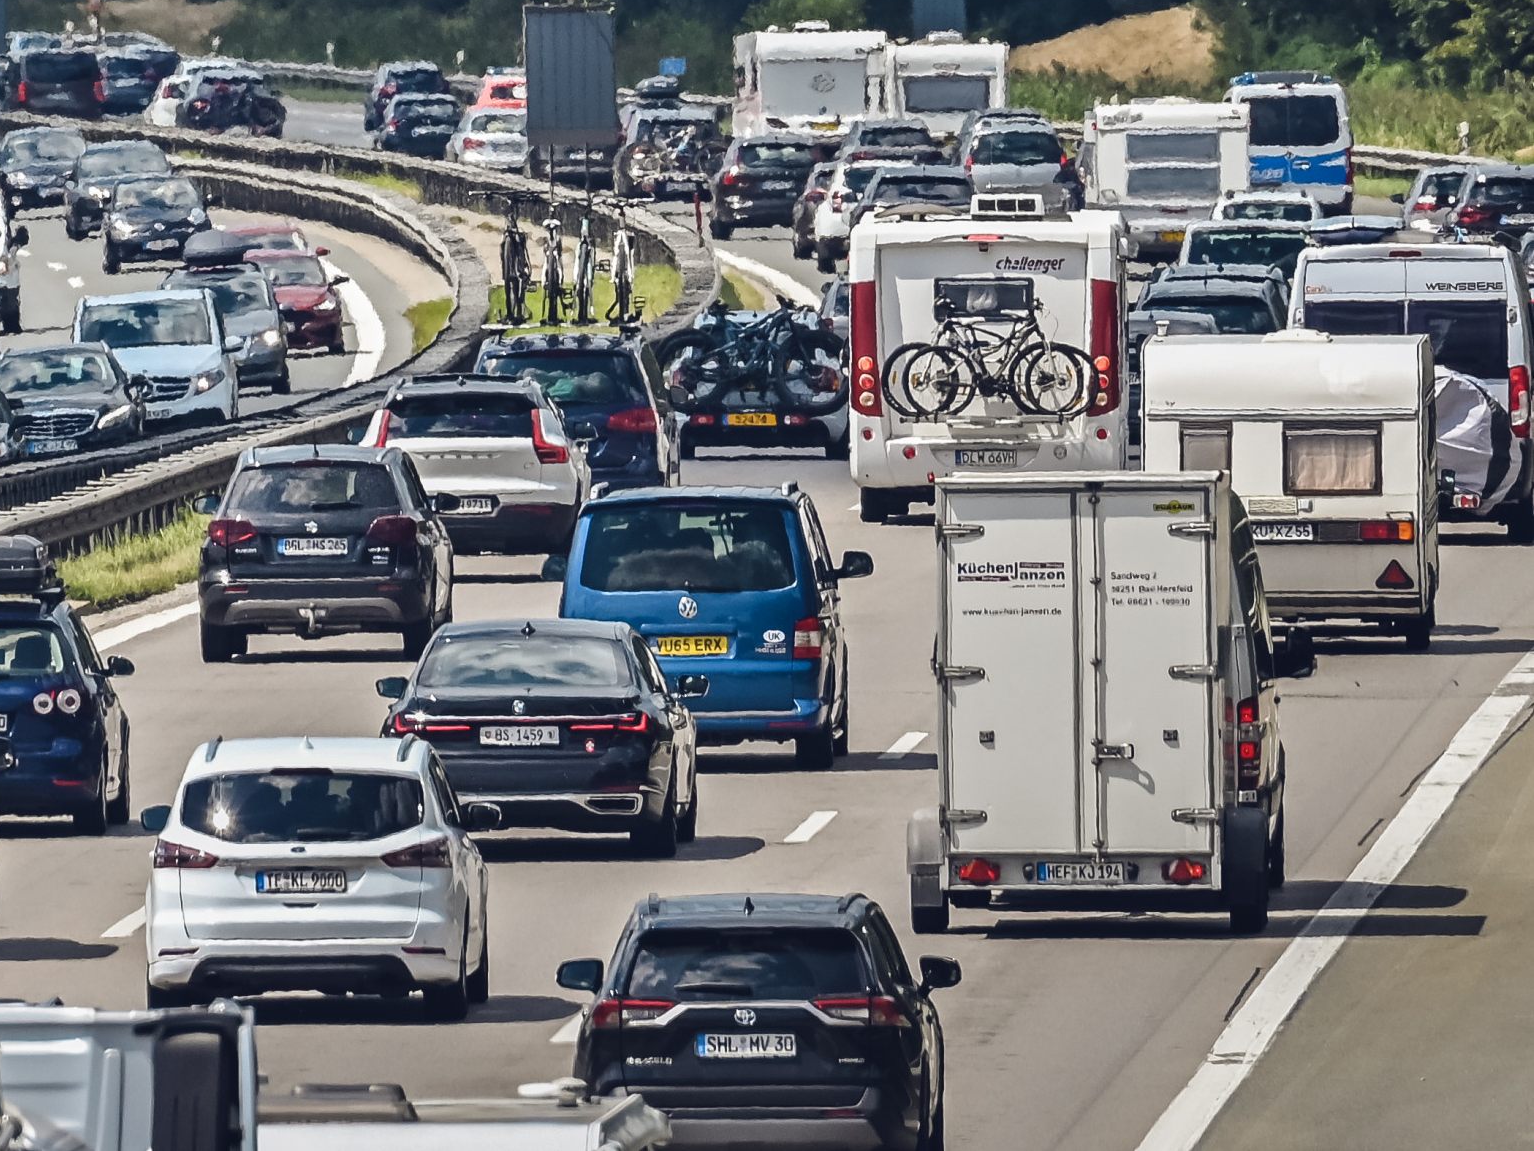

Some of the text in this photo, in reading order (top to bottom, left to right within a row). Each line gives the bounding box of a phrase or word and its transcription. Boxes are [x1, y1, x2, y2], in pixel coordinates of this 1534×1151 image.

[995, 255, 1065, 273] challenger
[1425, 281, 1503, 291] WEINSBERG
[962, 452, 1015, 464] DLW 66VH
[1295, 525, 1310, 538] 55
[957, 562, 1014, 575] Küchen
[768, 631, 781, 641] UK
[693, 637, 722, 652] ERX
[517, 729, 544, 741] 1459
[1047, 864, 1121, 879] HEF KJ 194
[291, 872, 308, 888] KL
[311, 871, 343, 888] 9000
[706, 1035, 794, 1053] SHL MV 30
